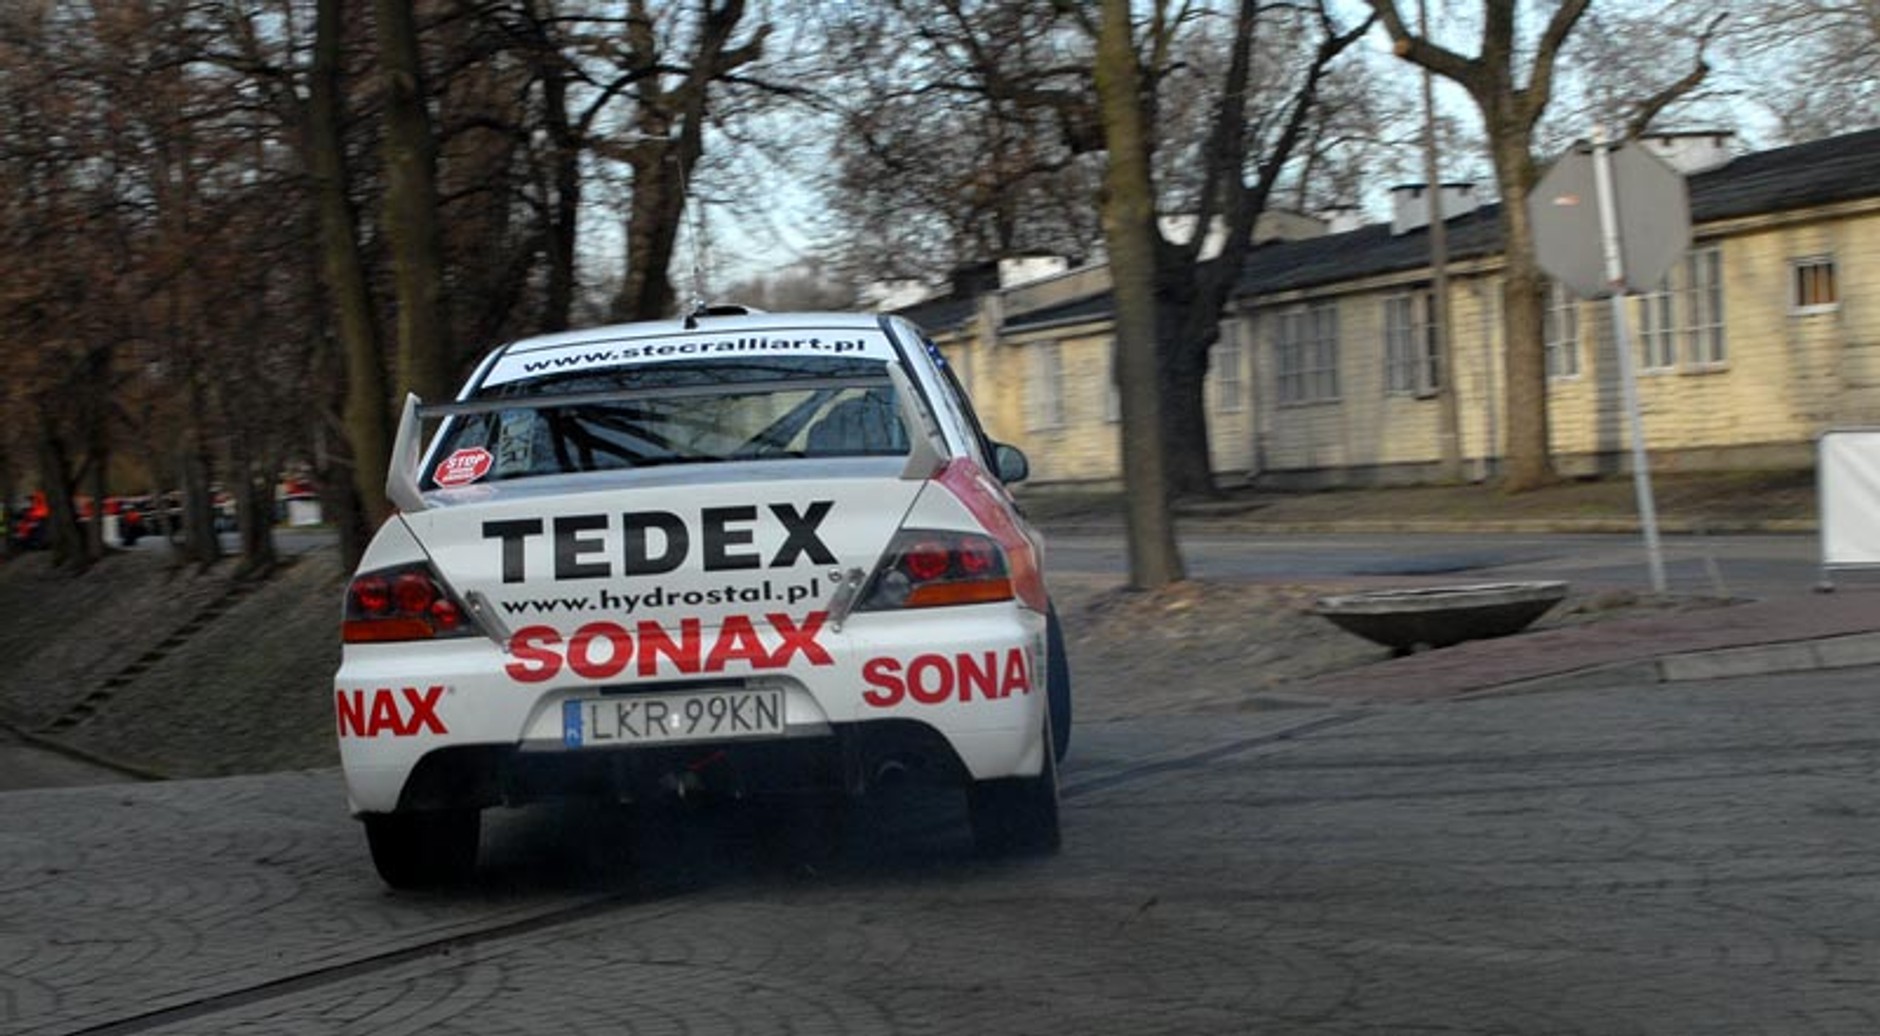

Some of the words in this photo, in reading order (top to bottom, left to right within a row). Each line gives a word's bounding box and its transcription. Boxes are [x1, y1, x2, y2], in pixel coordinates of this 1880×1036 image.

[523, 337, 867, 373] www.stecralliart.pl
[446, 453, 486, 469] STOP
[481, 500, 839, 584] TEDEX
[501, 578, 820, 614] www.hydrostal.pl
[504, 610, 835, 684] SONAX
[861, 646, 1030, 708] SONA
[336, 685, 449, 737] NAX
[591, 700, 669, 739] LKR
[685, 692, 779, 735] 99KN
